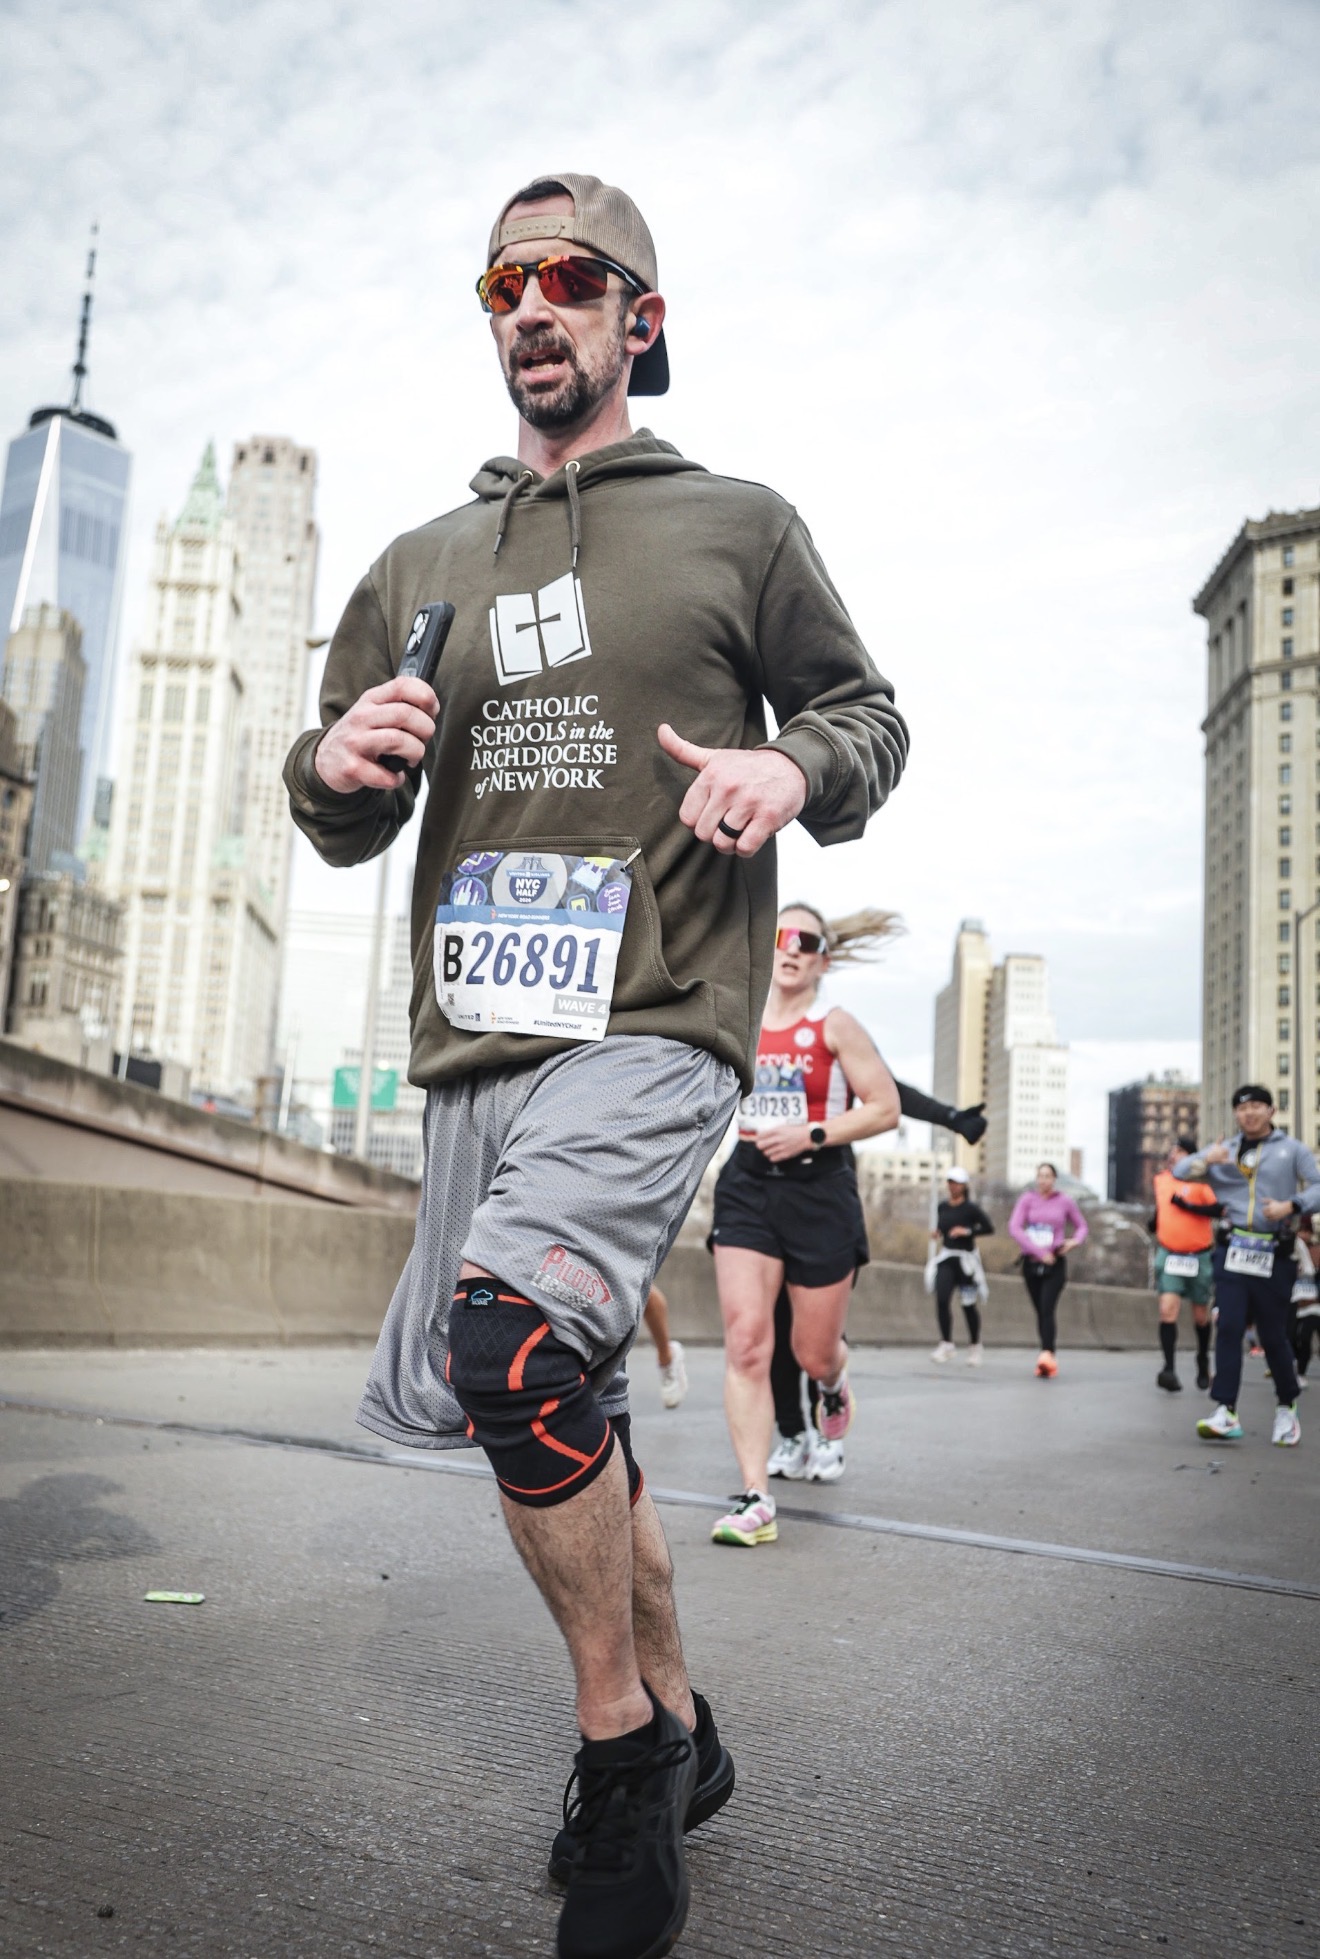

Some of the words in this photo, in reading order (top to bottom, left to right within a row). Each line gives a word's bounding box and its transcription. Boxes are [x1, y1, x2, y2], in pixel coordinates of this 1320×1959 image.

[482, 695, 598, 721] CATHOLIC
[470, 721, 566, 747] SCHOOLS
[570, 723, 586, 740] in
[589, 721, 614, 740] the
[470, 743, 617, 770] ARCHDIOCESE
[475, 777, 490, 800] of
[489, 770, 539, 792] NEW
[541, 767, 604, 789] YORK
[515, 878, 541, 889] NYC
[516, 889, 538, 897] HALF
[558, 999, 596, 1014] WAVE
[598, 1004, 607, 1015] 4
